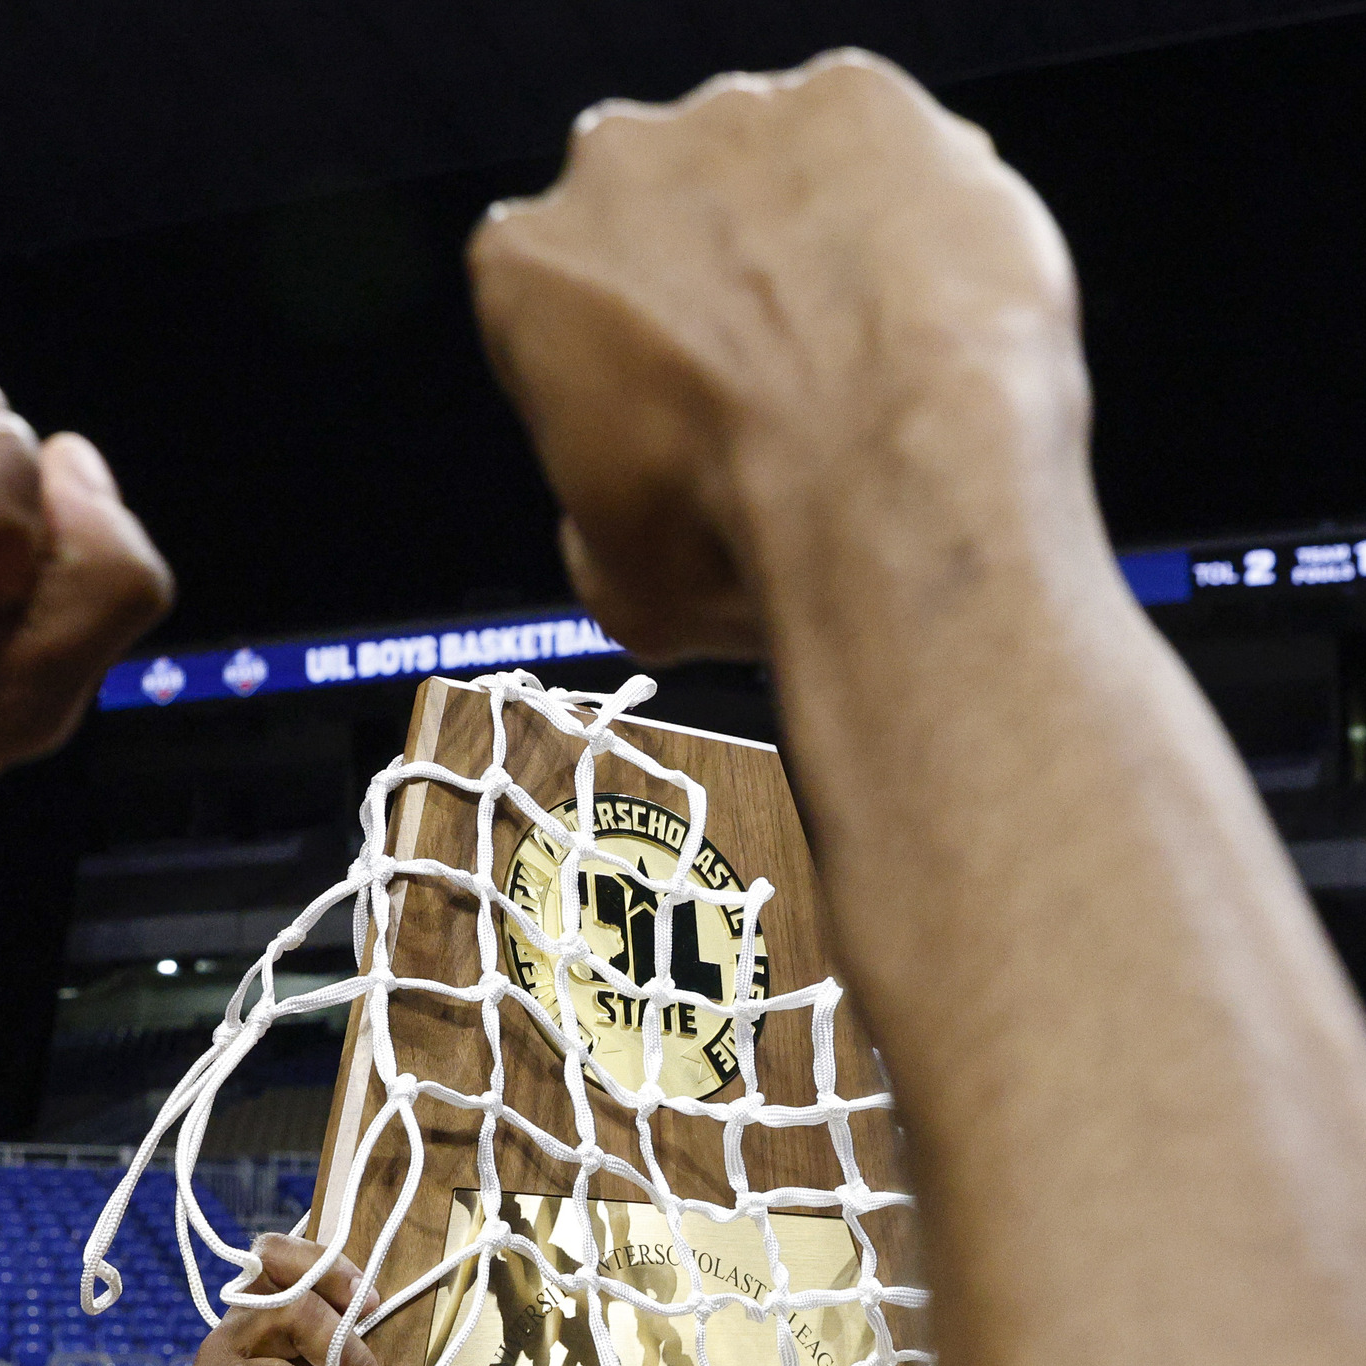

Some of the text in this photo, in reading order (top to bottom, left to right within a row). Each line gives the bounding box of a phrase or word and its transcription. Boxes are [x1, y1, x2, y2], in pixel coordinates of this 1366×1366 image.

[1242, 548, 1277, 587] 2
[305, 644, 355, 684] UIL
[356, 634, 438, 679] BOYS
